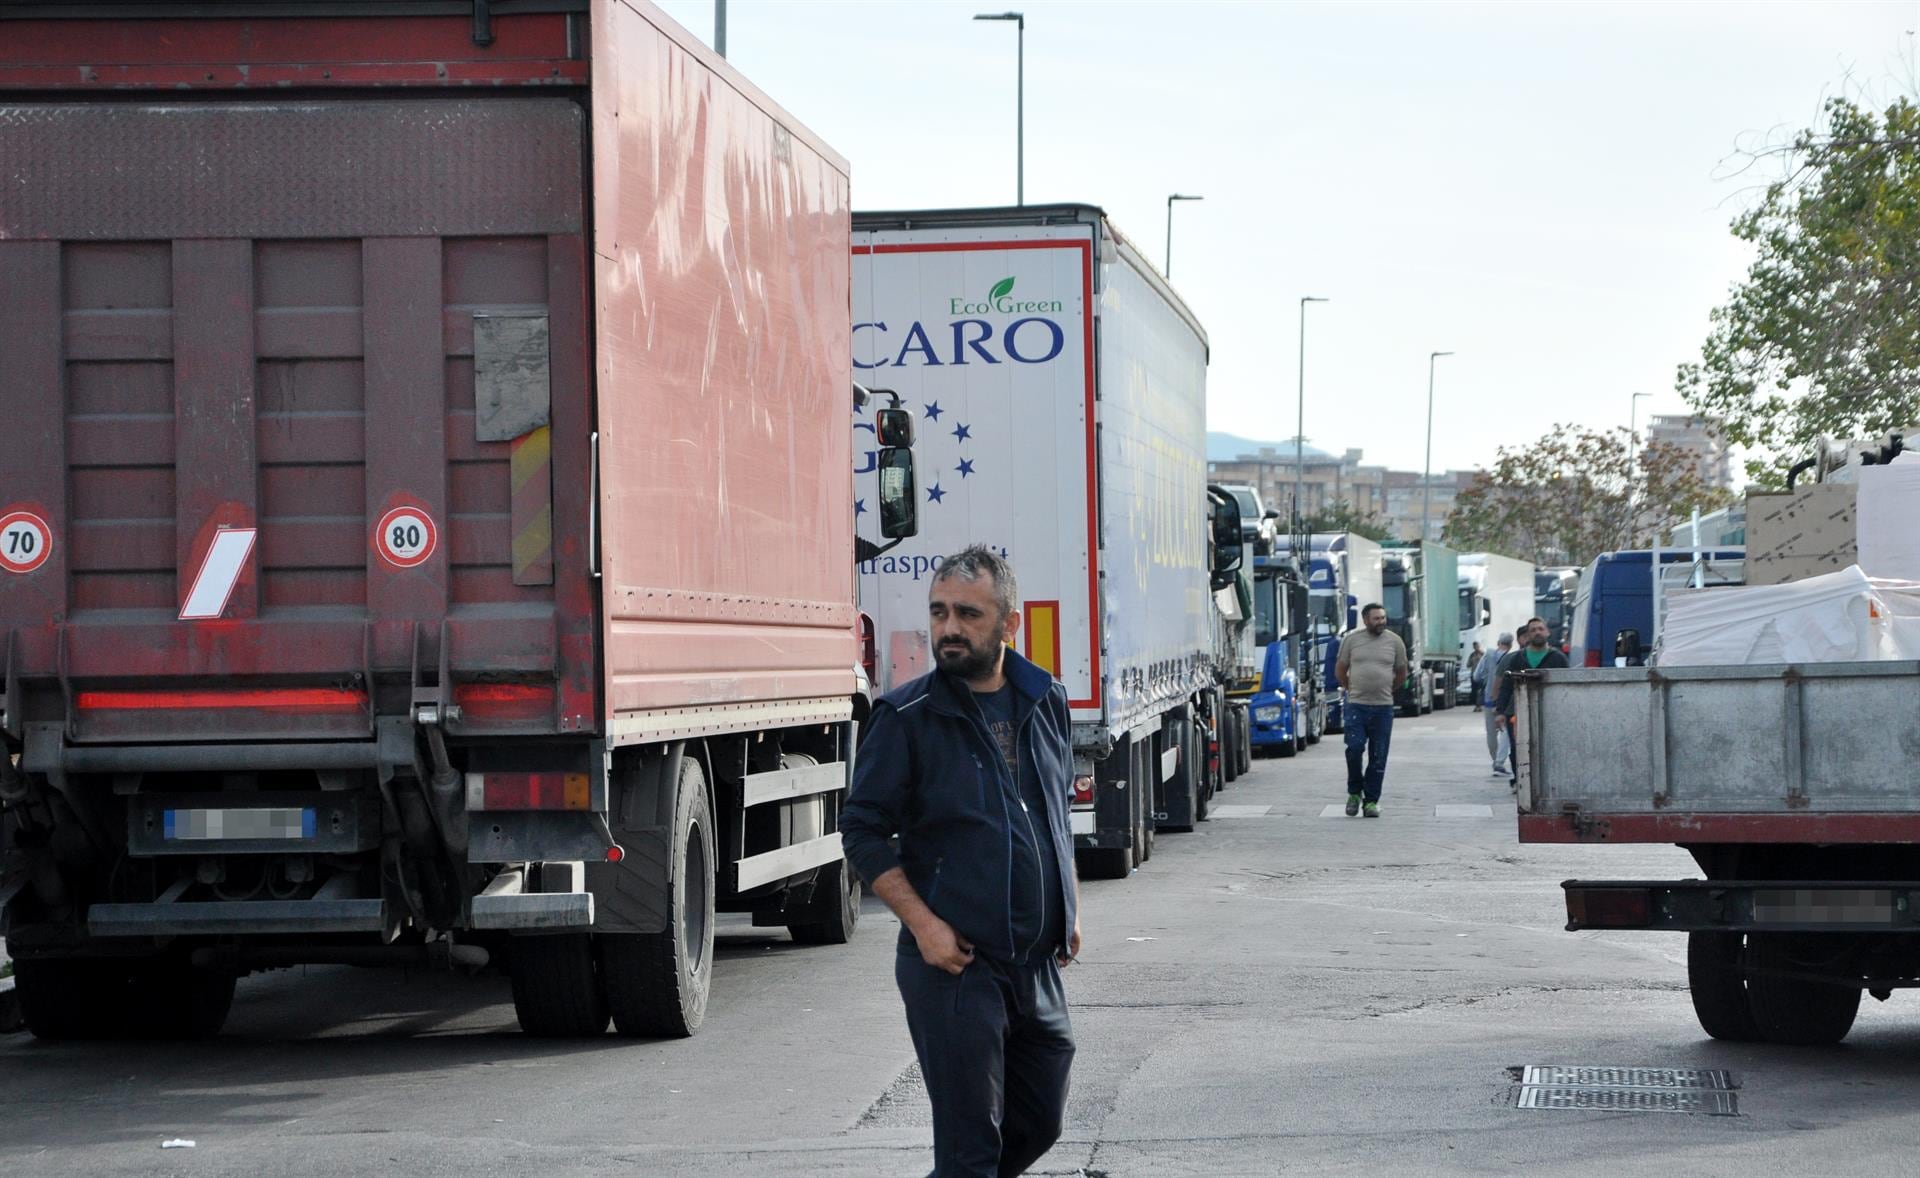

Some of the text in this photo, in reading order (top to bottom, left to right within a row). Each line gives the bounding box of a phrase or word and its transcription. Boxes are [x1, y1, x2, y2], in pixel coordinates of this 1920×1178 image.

[950, 296, 1063, 315] Eco Green
[853, 317, 1065, 369] CARO
[8, 531, 35, 554] 70
[393, 525, 420, 548] 80
